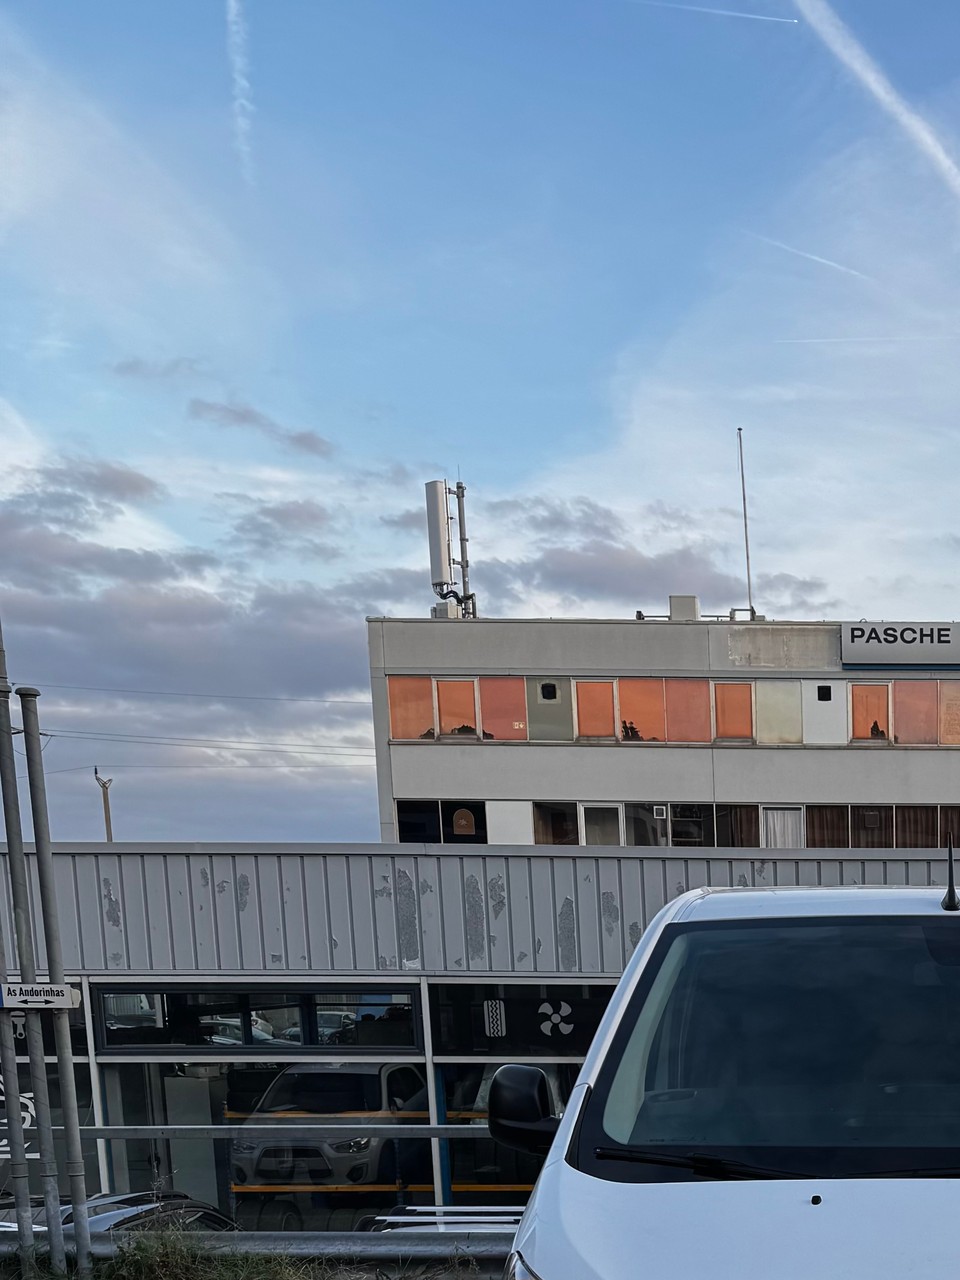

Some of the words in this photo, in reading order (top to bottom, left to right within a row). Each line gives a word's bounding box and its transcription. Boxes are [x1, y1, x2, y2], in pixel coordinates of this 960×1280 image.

[850, 627, 951, 644] PASCHE
[7, 987, 17, 997] As
[19, 987, 65, 997] Andorinhas
